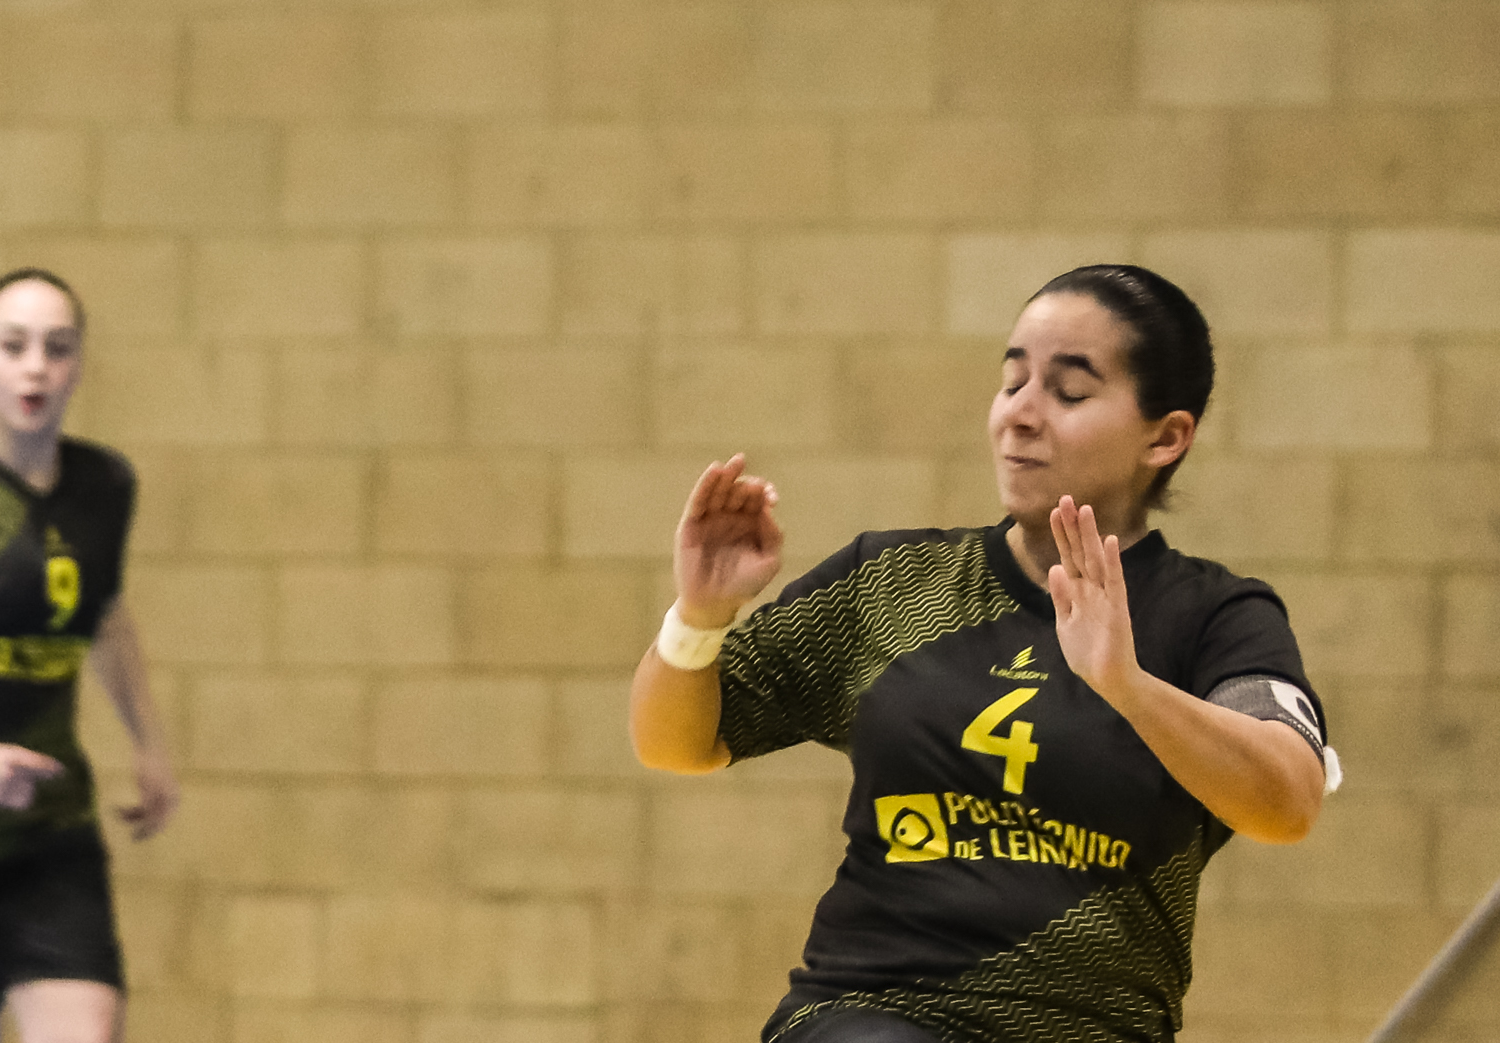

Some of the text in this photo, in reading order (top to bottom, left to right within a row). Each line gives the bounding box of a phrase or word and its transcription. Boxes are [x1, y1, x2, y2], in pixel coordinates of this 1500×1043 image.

[46, 556, 81, 632] 9
[961, 687, 1039, 795] 4
[954, 838, 985, 861] DE
